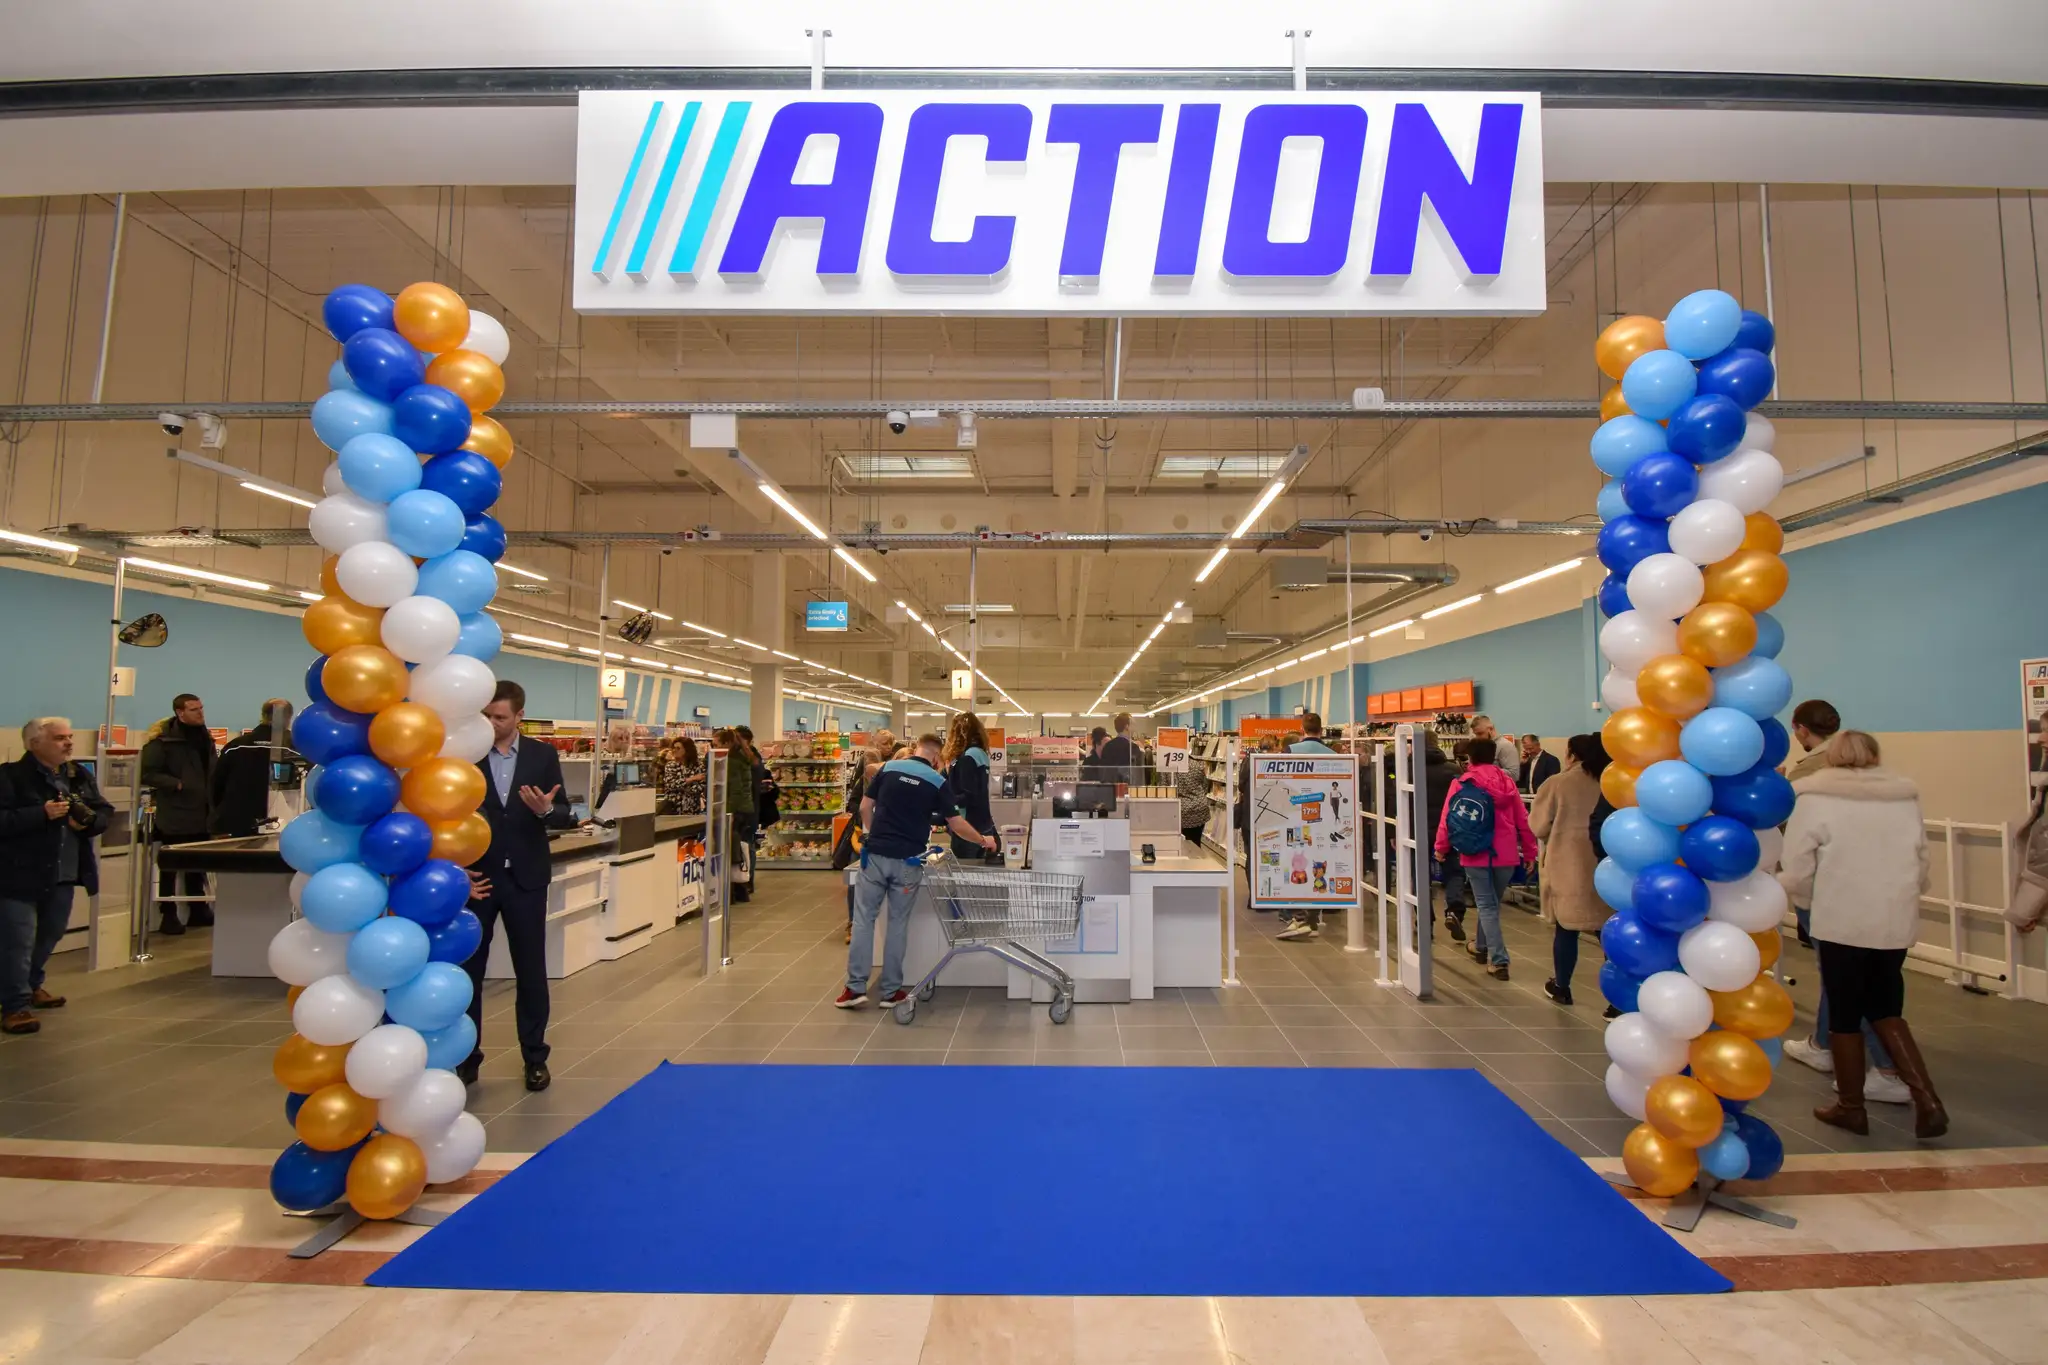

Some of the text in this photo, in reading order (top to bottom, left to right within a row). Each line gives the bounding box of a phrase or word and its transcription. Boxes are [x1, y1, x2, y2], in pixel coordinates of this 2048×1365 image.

[718, 101, 1523, 276] ACTION
[112, 672, 119, 686] 4
[608, 674, 618, 688] 2
[956, 676, 962, 689] 1
[1266, 761, 1315, 773] ACTION
[1337, 880, 1351, 889] 599
